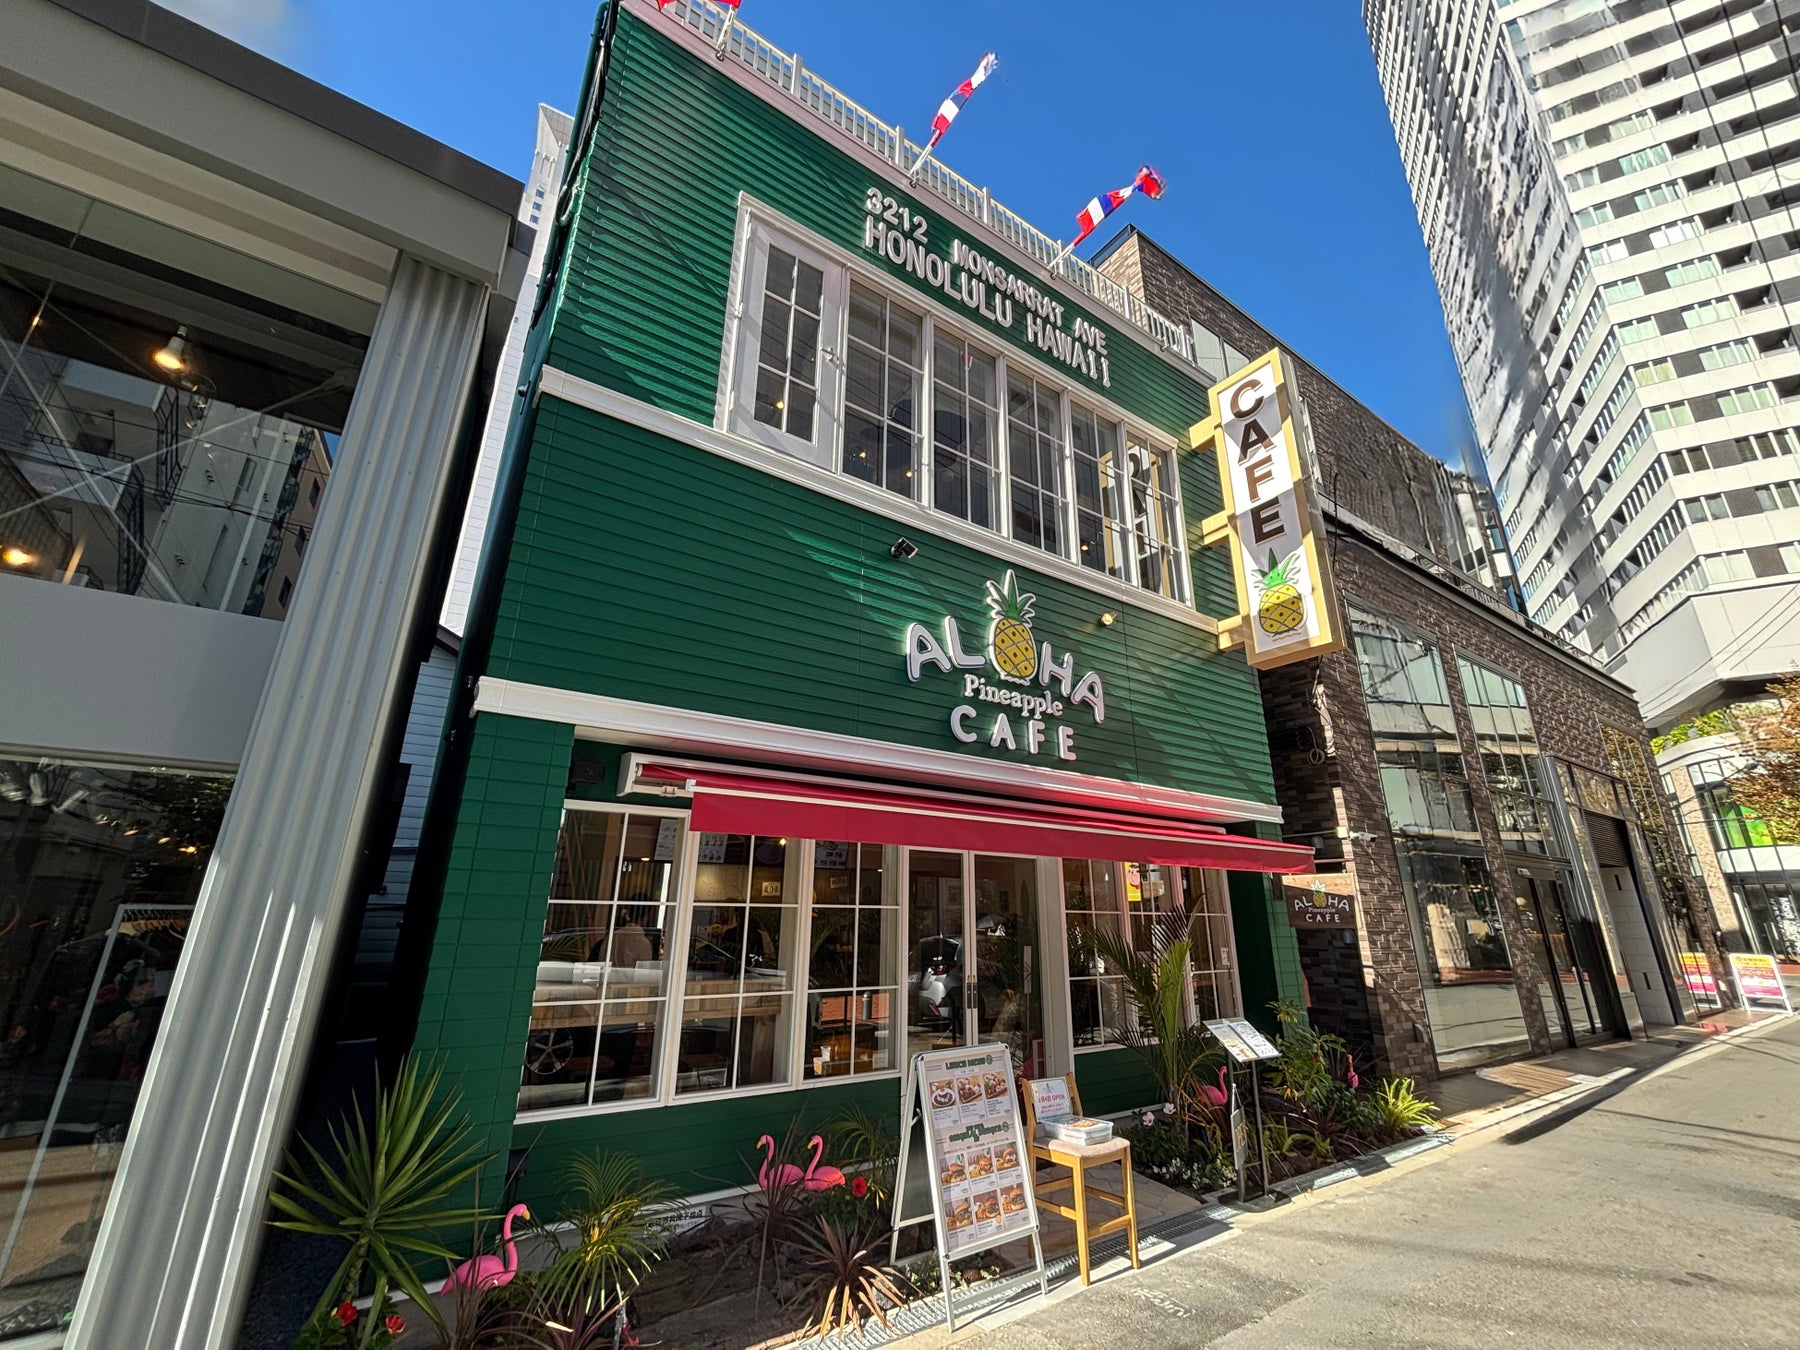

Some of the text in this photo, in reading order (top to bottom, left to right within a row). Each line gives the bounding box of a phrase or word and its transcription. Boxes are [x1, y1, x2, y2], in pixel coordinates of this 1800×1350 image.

[866, 187, 1108, 356] 3212 MONSARRAT AVE
[866, 215, 1013, 328] HONOLULU
[1230, 379, 1285, 545] CAFE
[950, 705, 1076, 761] CAFE
[964, 673, 1063, 719] Pineapple
[1306, 914, 1341, 923] CAFE
